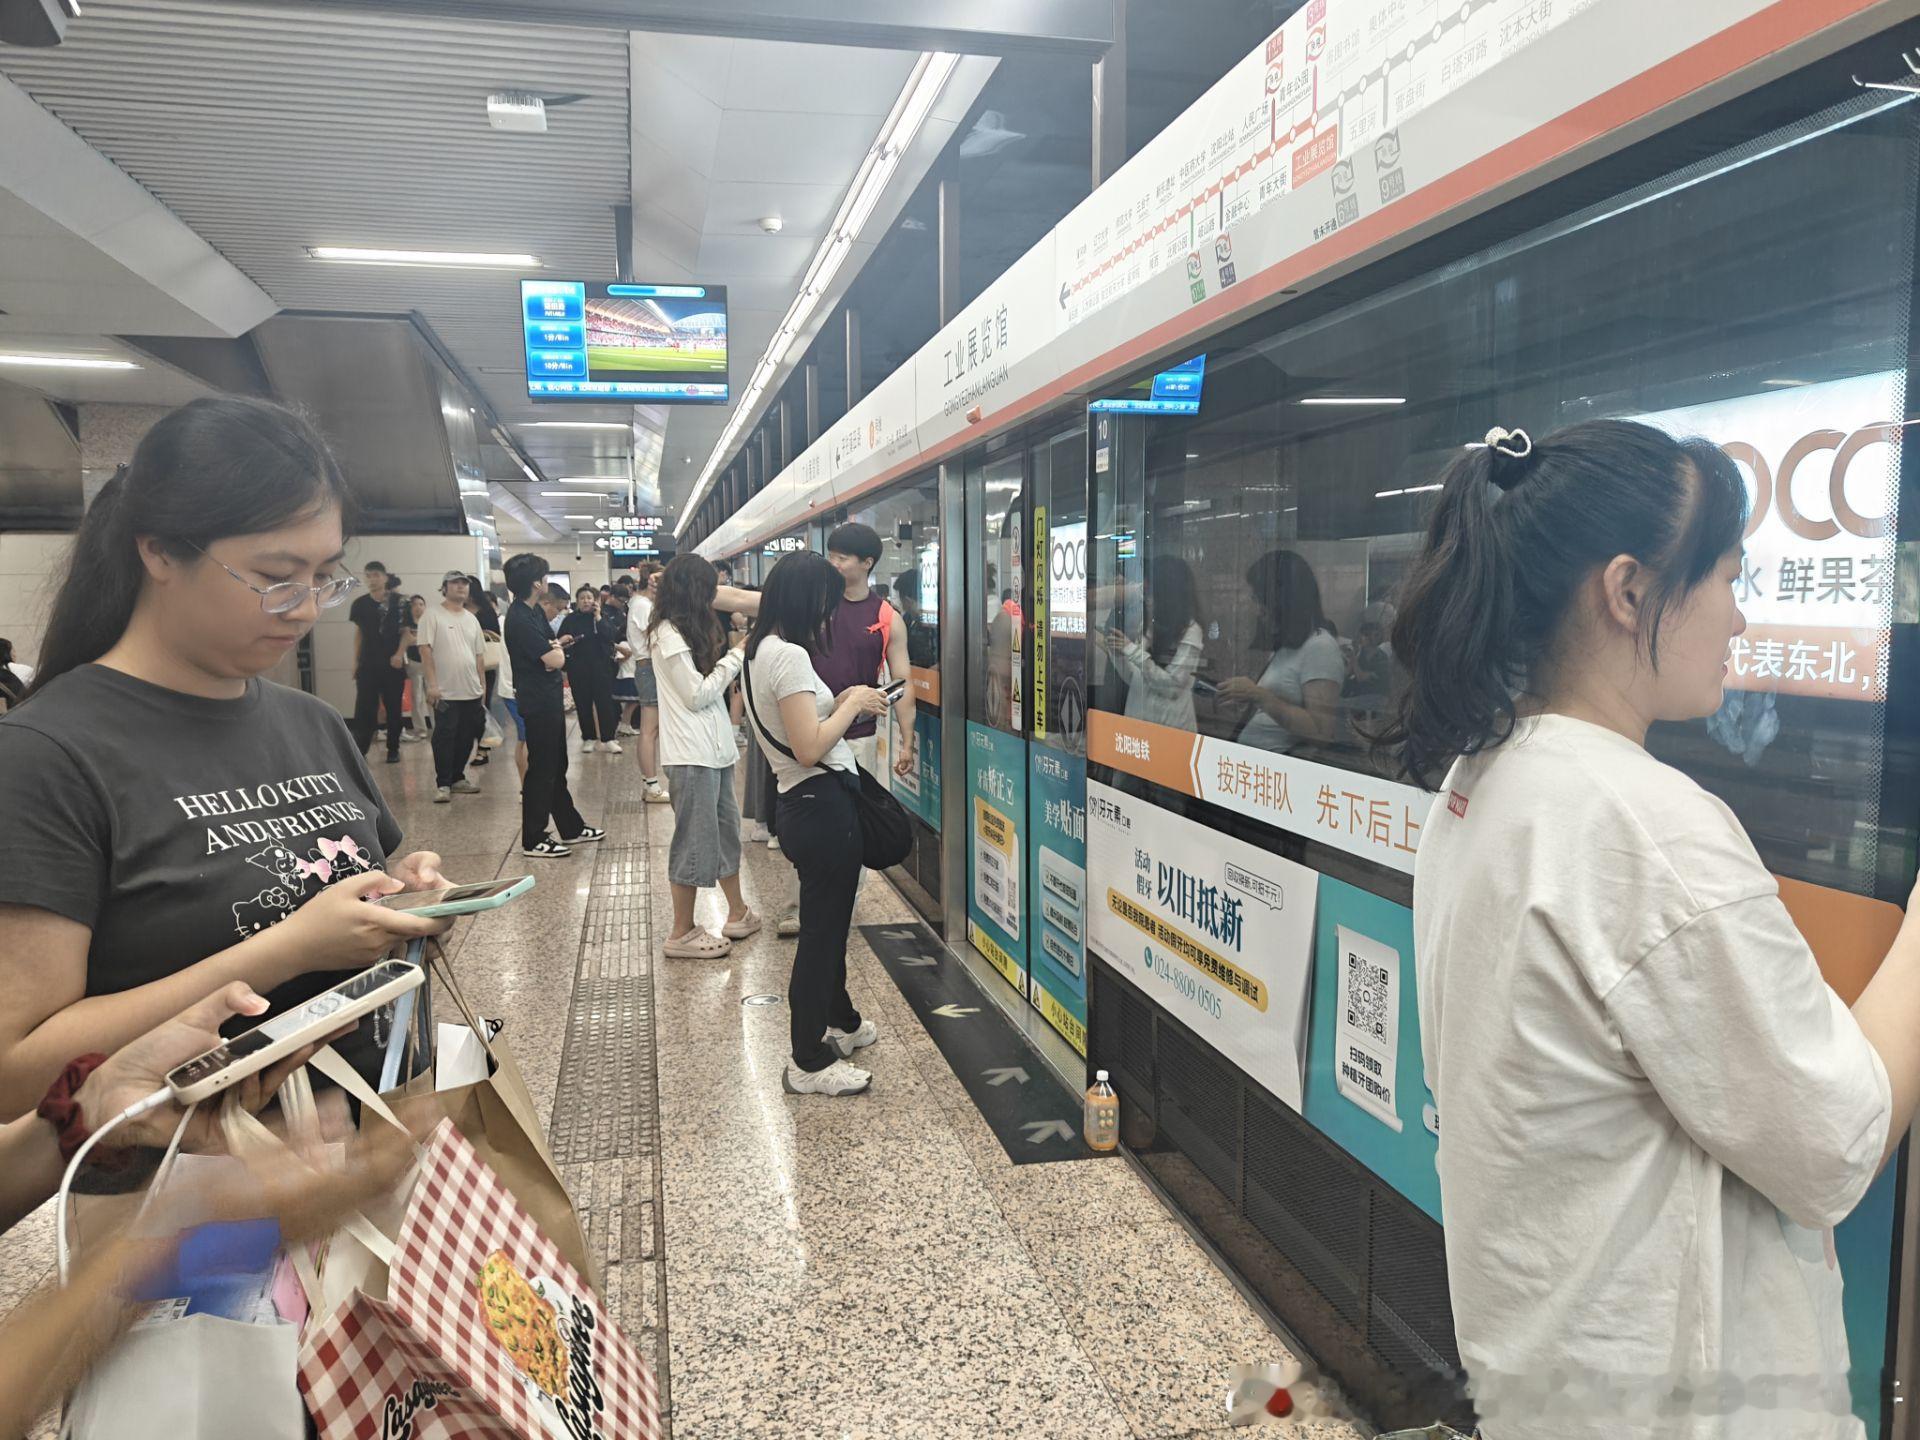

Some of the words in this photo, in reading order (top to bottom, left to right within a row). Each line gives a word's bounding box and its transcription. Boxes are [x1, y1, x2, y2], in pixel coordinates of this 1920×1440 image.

[943, 303, 1008, 388] 工业展览馆
[943, 363, 1009, 417] GONGYEZHANLANGUAN
[1114, 732, 1150, 761] 沈阳地铁
[173, 783, 279, 820] HELLO
[277, 771, 344, 804] KITTY
[1217, 755, 1293, 815] 按序排队
[1316, 783, 1421, 855] 先下后上
[206, 820, 268, 855] AND
[265, 800, 365, 840] FRIENDS
[1044, 798, 1085, 845] 美学贴面
[1134, 847, 1151, 874] 活动
[1136, 873, 1152, 900] 假牙
[1157, 860, 1244, 953] 以旧抵新
[1154, 954, 1196, 1000] 024-8809
[1198, 984, 1223, 1021] 0505
[1341, 1061, 1391, 1104] 种植牙团购价
[1349, 1046, 1383, 1078] 扫码领取
